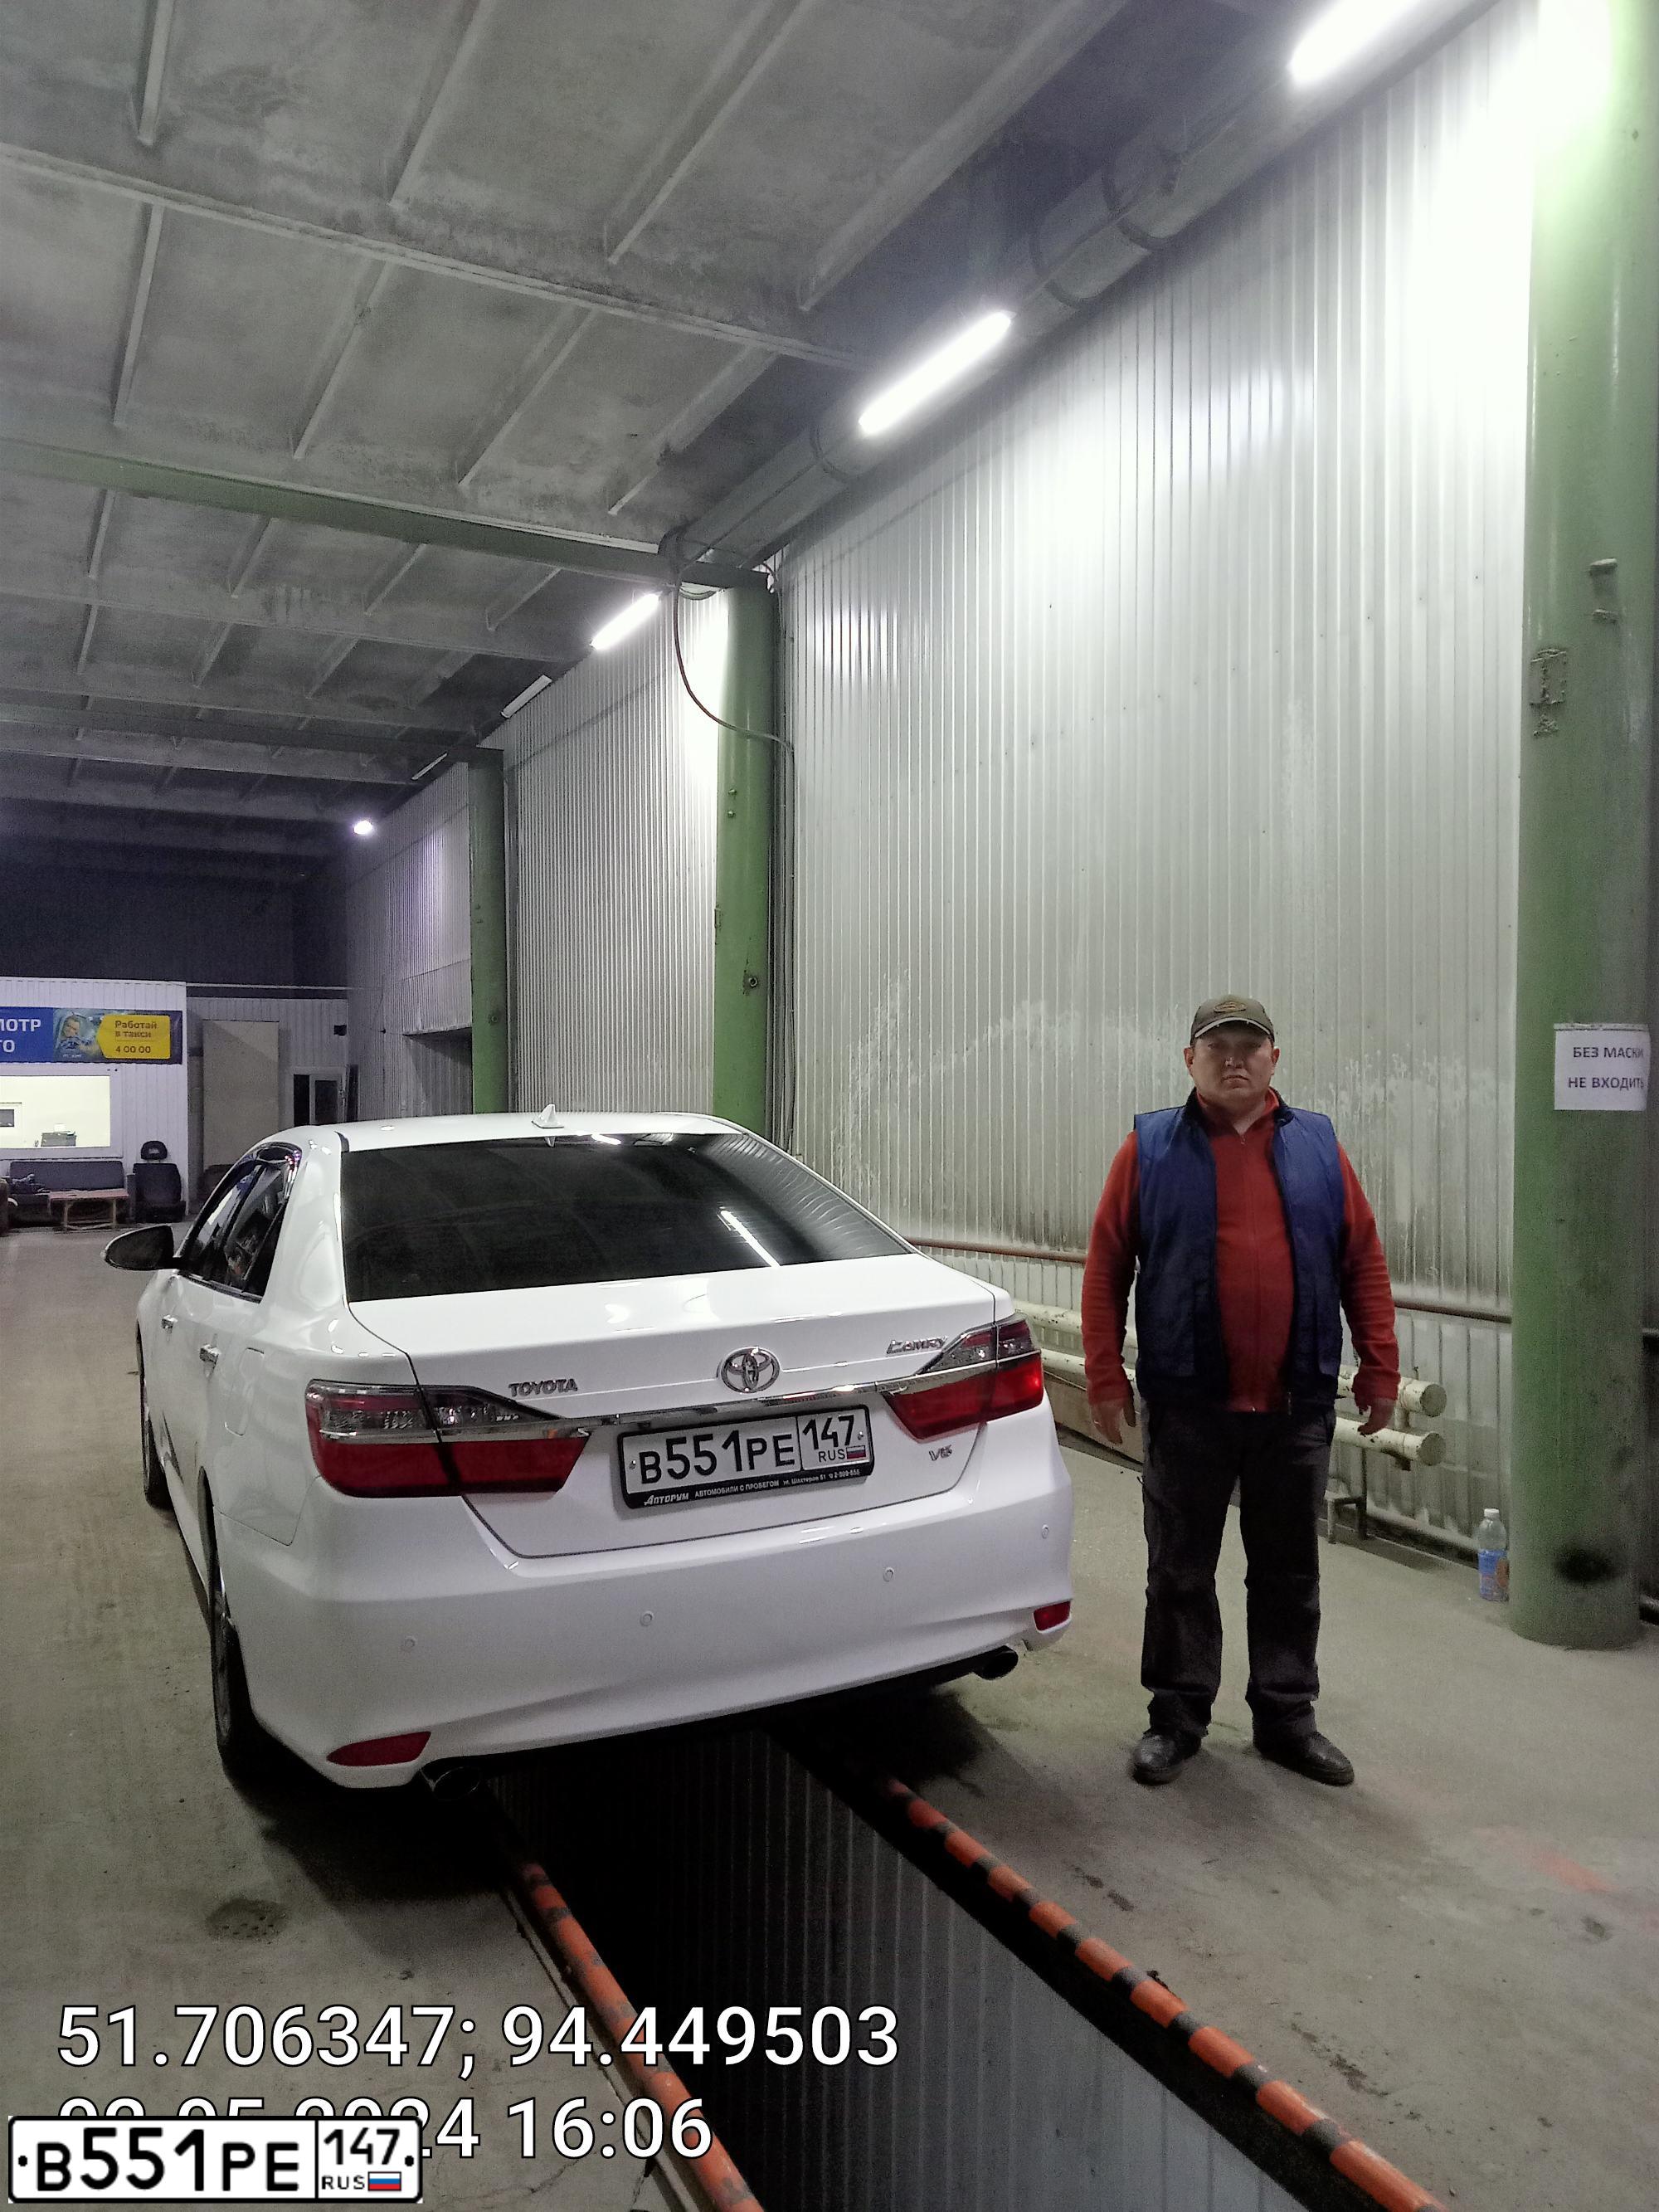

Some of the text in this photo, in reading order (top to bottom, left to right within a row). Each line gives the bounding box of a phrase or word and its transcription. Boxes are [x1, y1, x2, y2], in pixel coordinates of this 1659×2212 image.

[115, 1020, 158, 1029] Работай
[0, 1039, 16, 1053] О
[1573, 1046, 1645, 1059] БЕЗ МАСКИ
[1568, 1077, 1645, 1091] НЕ ВХОДИТЬ
[508, 1377, 579, 1397] TOYOTA
[801, 1415, 855, 1450] 147
[818, 1448, 846, 1463] RUS
[694, 1484, 739, 1498] АВТОМОБИЛИ
[745, 1479, 780, 1491] ПРОБЕГОМ
